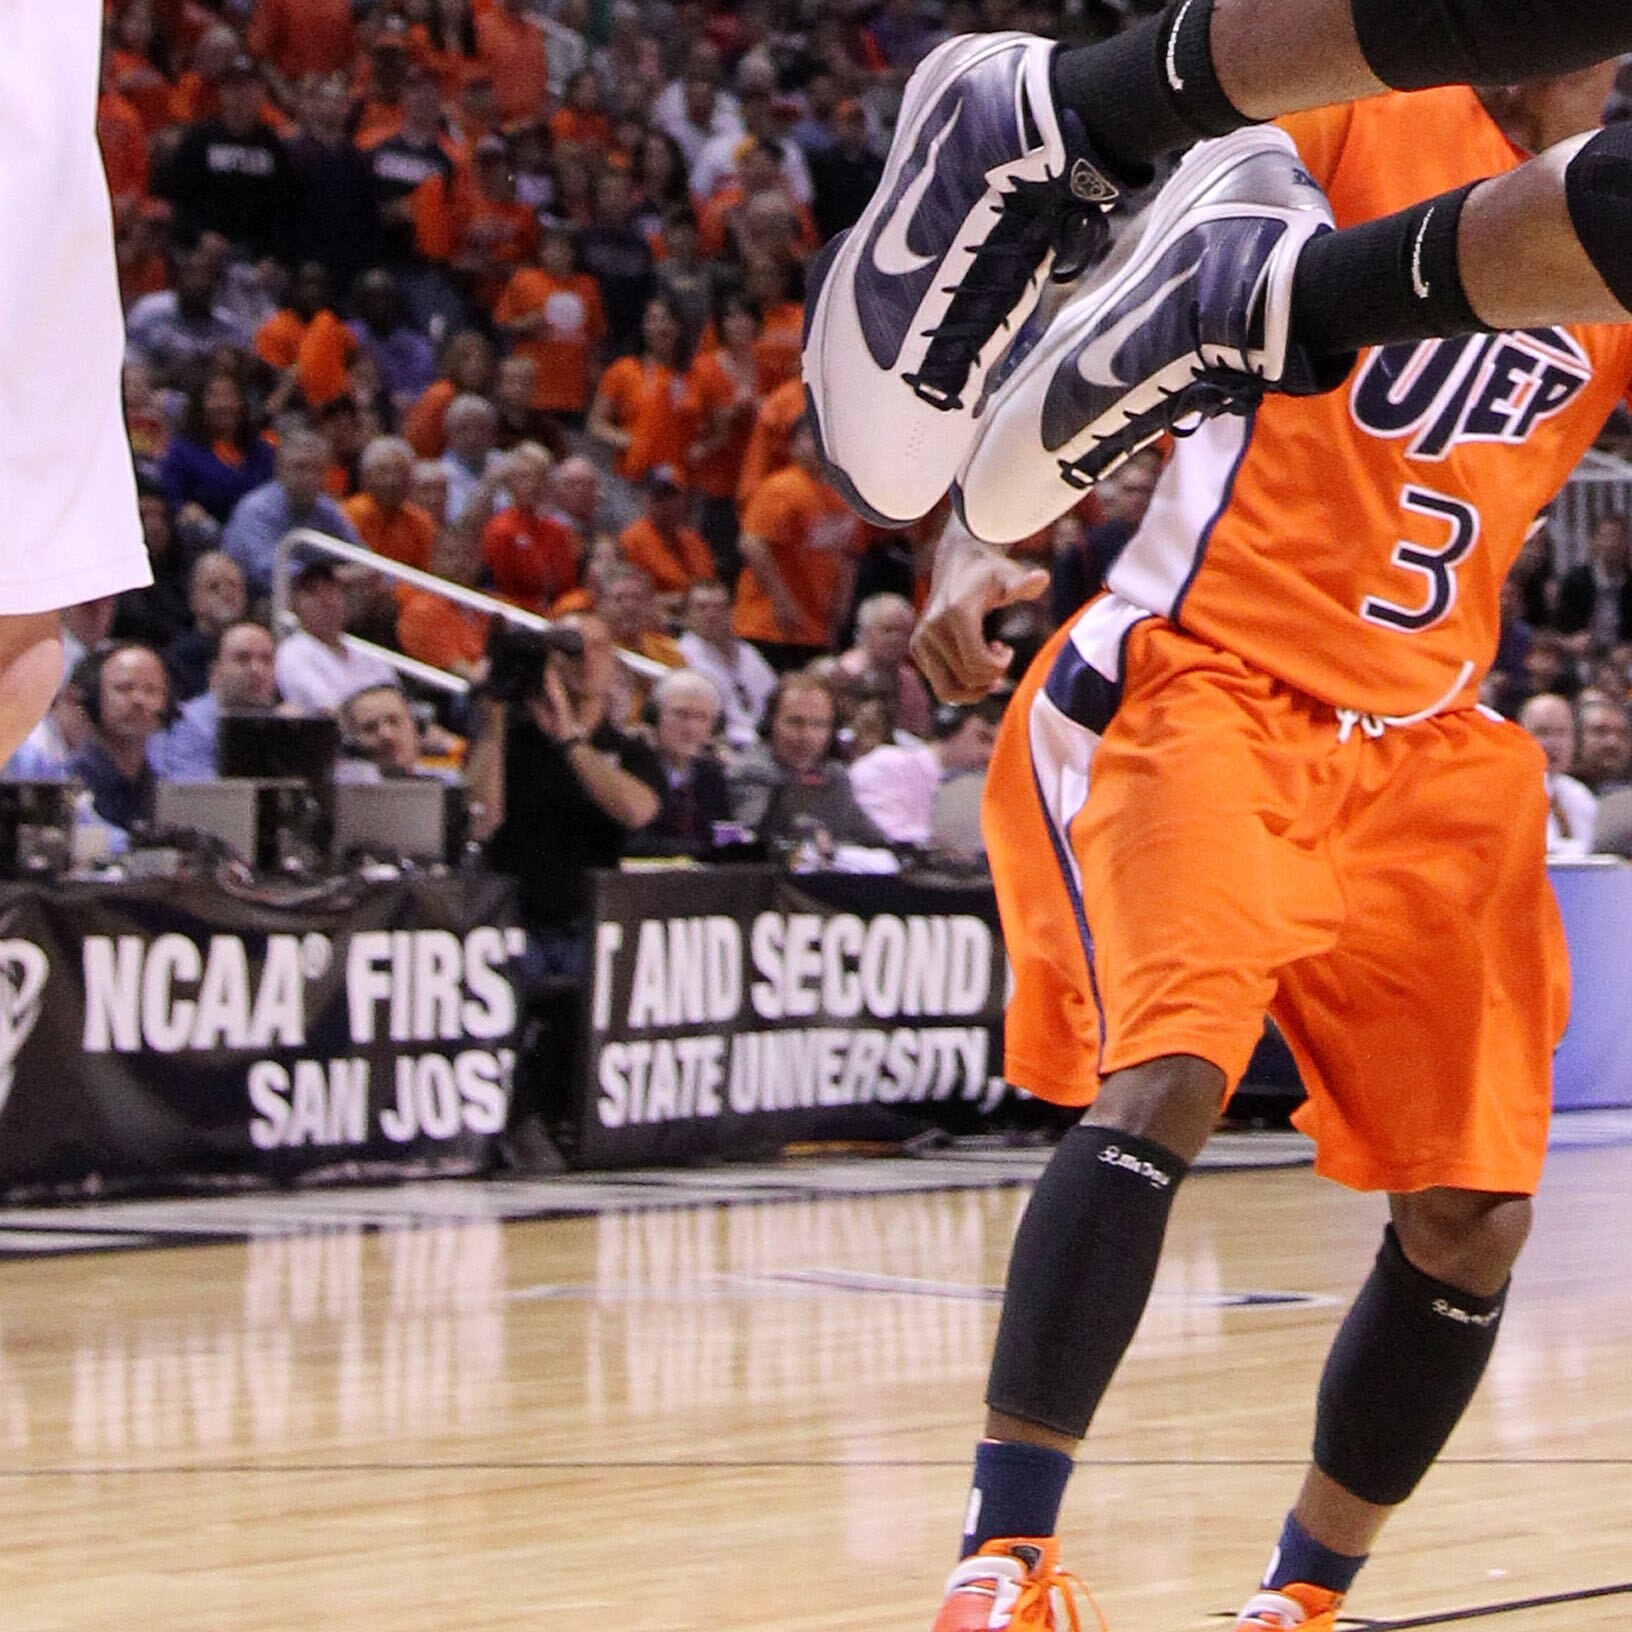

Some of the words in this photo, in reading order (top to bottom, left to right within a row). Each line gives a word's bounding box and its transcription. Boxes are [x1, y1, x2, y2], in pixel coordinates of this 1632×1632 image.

[1350, 325, 1593, 462] UTEP
[1360, 483, 1480, 633] 3
[628, 914, 743, 1029] AND
[750, 911, 993, 1020] SECOND
[247, 1056, 370, 1150] SAN
[600, 1036, 725, 1128] STATE
